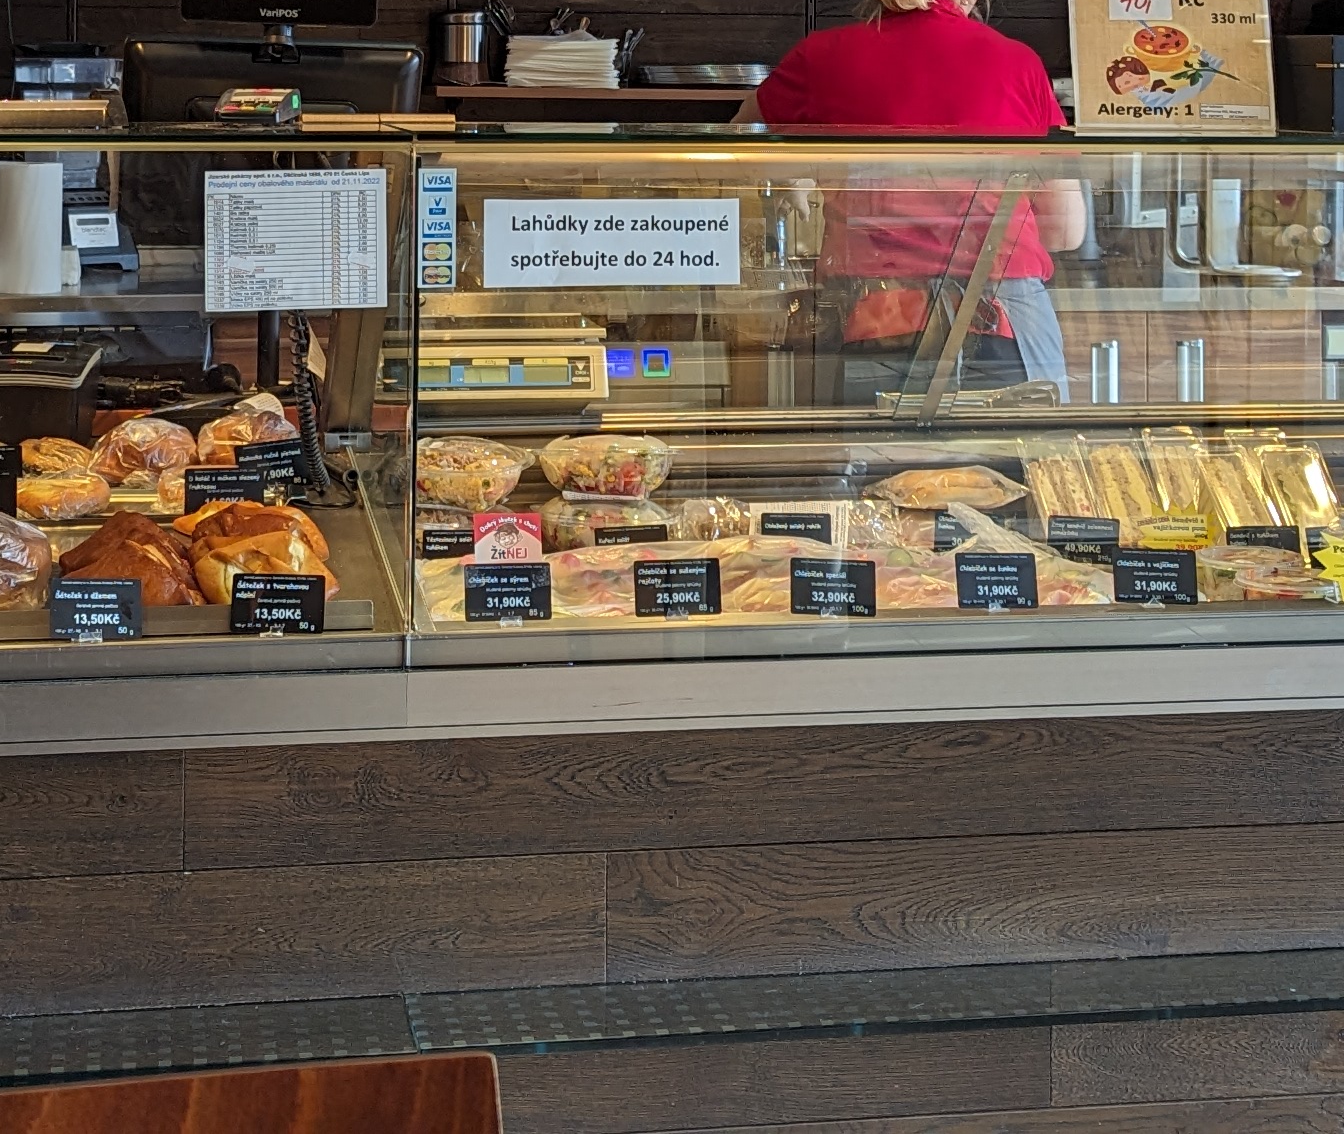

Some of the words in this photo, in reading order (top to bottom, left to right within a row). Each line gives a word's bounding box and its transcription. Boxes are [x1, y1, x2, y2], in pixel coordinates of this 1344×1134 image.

[259, 8, 299, 18] VariPOS
[1211, 13, 1235, 24] 330
[1239, 13, 1256, 24] ml
[1097, 103, 1179, 118] Alergeny:
[1185, 104, 1193, 115] 1
[427, 176, 452, 185] VISA
[427, 221, 451, 231] VISA
[511, 214, 589, 236] Lahůdky
[593, 215, 626, 232] zde
[631, 214, 729, 237] zakoupené
[511, 250, 620, 270] spotřebujte
[624, 250, 648, 267] do
[652, 251, 675, 267] 24
[680, 250, 720, 267] hod.
[491, 546, 528, 560] ŽítNEJ
[976, 584, 1018, 597] 31,90Kč
[1134, 579, 1177, 592] 31,90Kč
[487, 592, 531, 609] 31,90Kč
[656, 592, 700, 605] 25,90Kč
[812, 590, 855, 603] 32,90Kč
[73, 612, 120, 626] 13,50Kč
[254, 608, 302, 621] 13,50Kč
